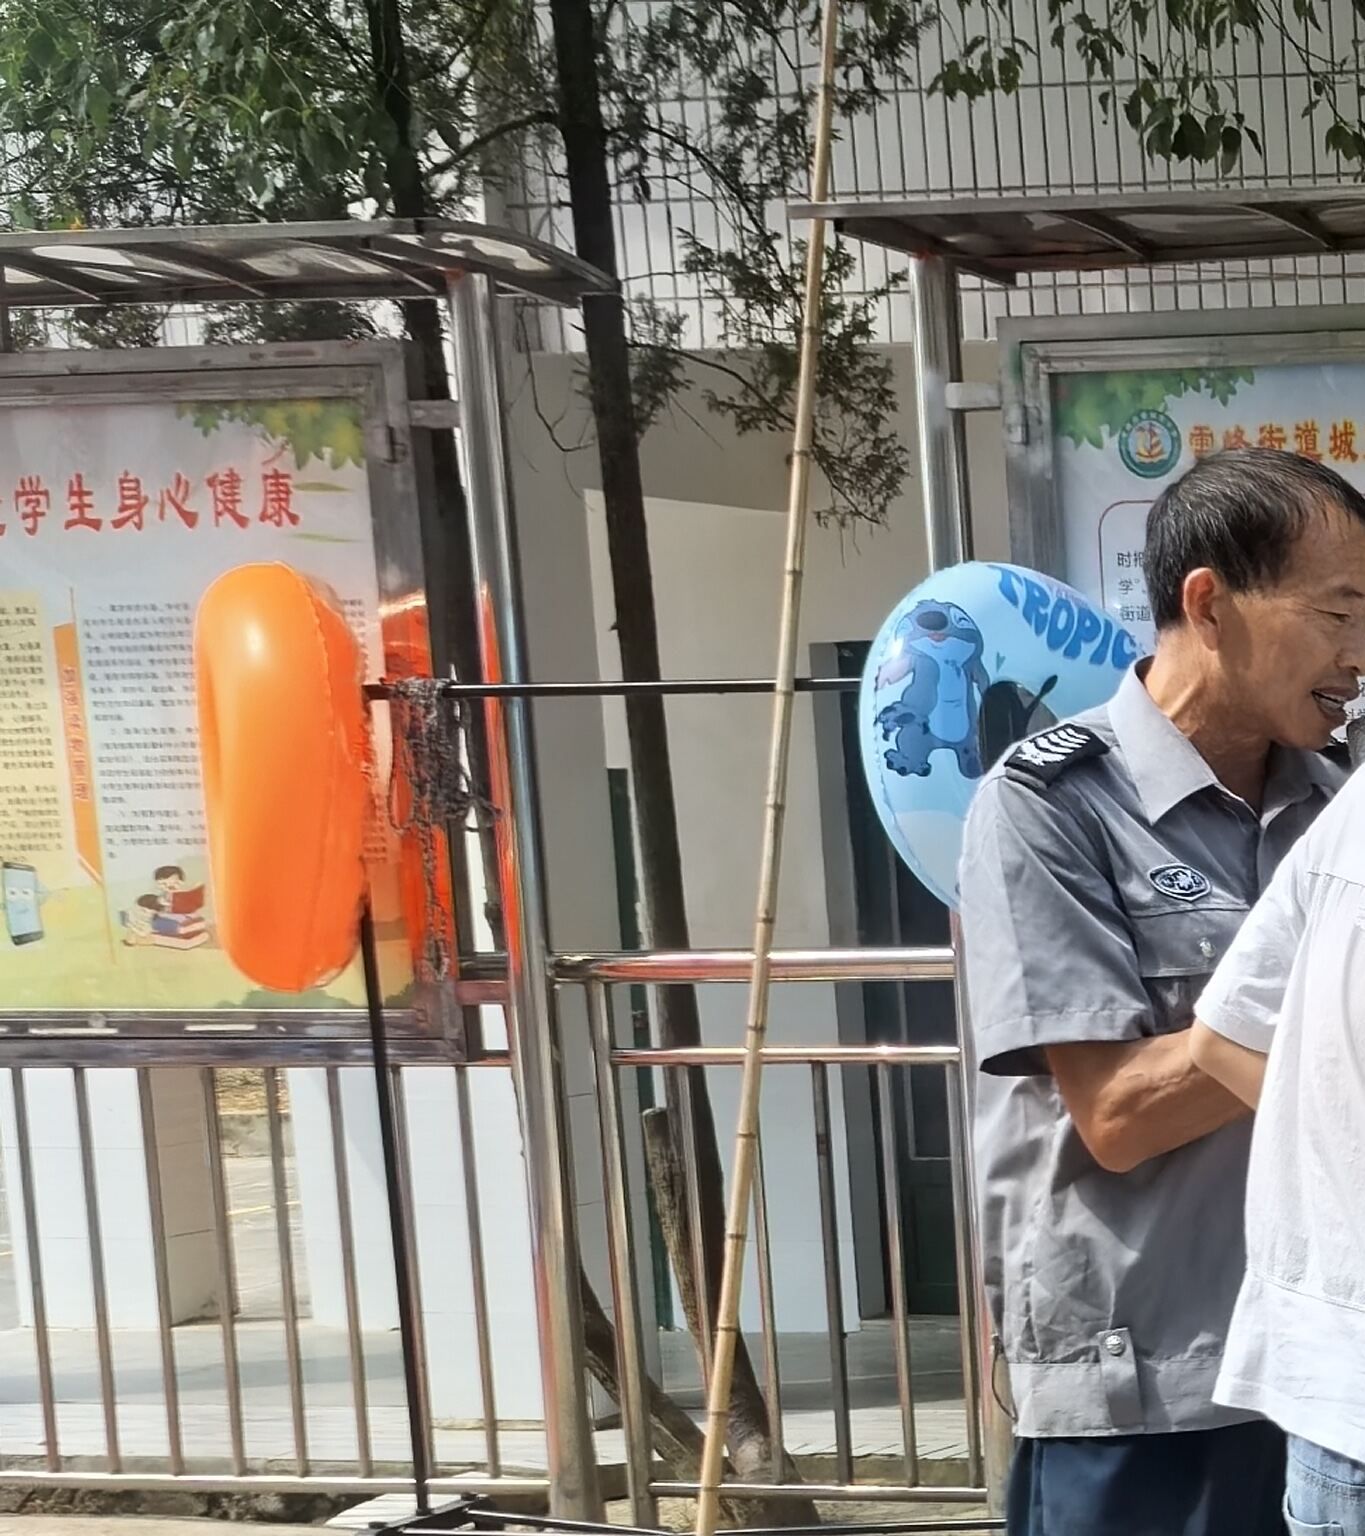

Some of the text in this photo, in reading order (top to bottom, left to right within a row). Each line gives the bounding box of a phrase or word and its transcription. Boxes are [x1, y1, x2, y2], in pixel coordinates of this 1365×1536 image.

[0, 467, 301, 537] 学生身心健康
